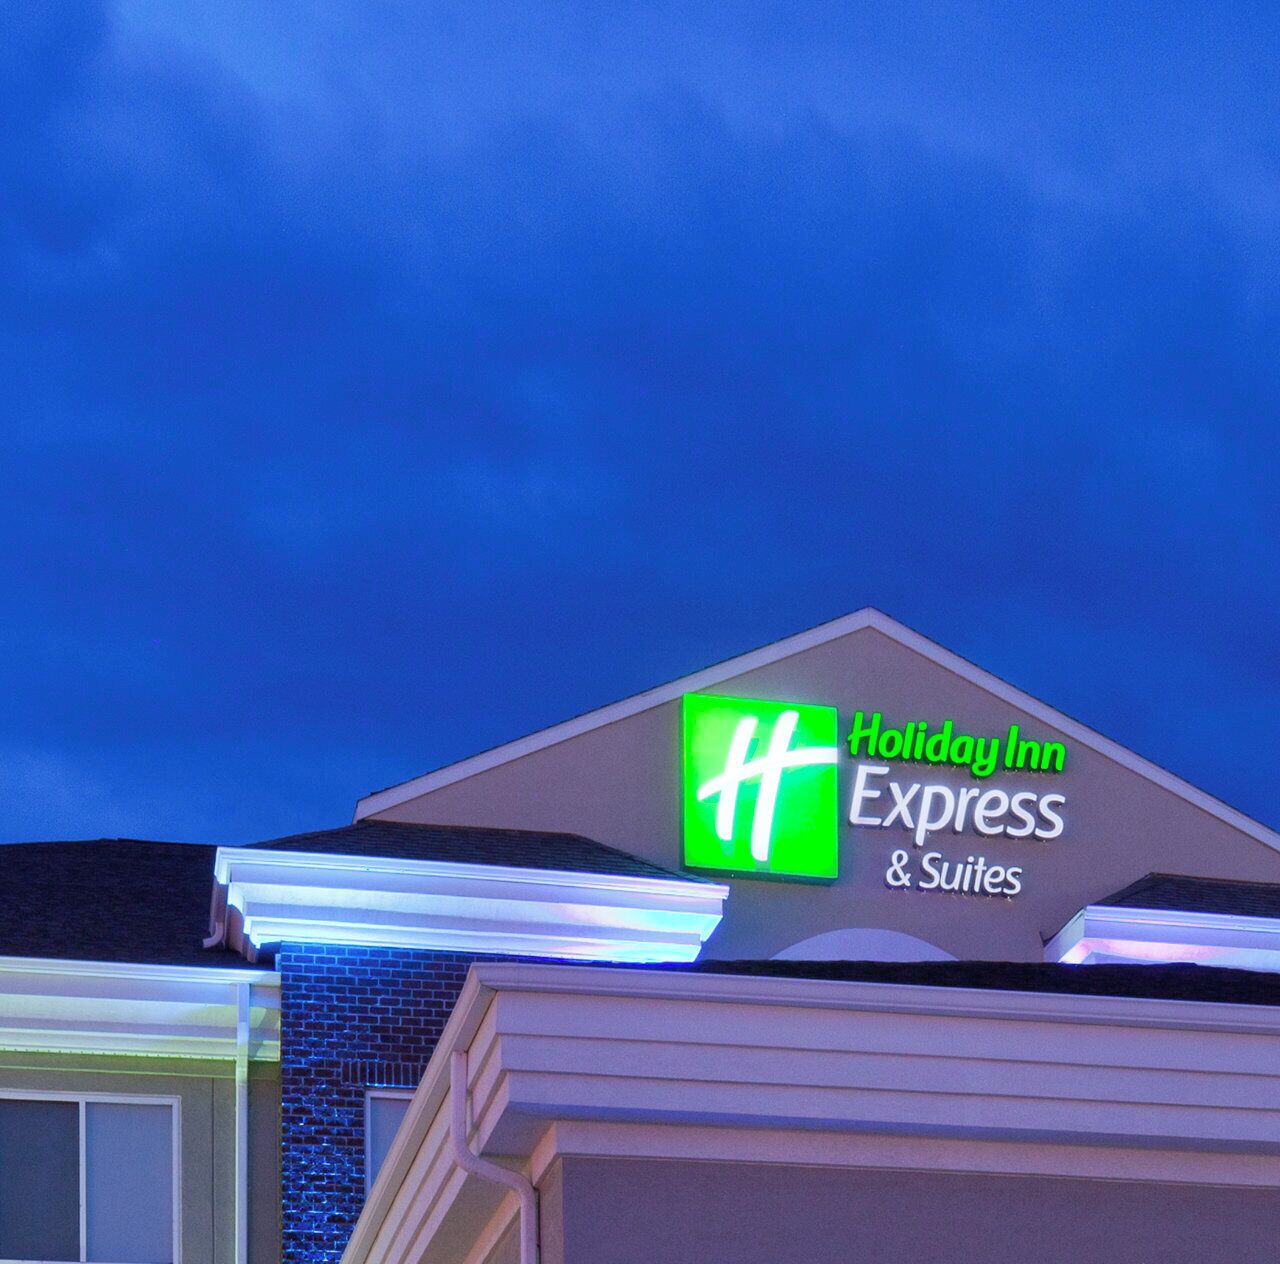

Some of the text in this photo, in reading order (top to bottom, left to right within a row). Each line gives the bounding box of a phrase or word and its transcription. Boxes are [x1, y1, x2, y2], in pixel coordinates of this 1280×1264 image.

[848, 711, 1066, 777] Holiday Inn
[849, 764, 1066, 847] Express
[885, 849, 1023, 896] & Suites
